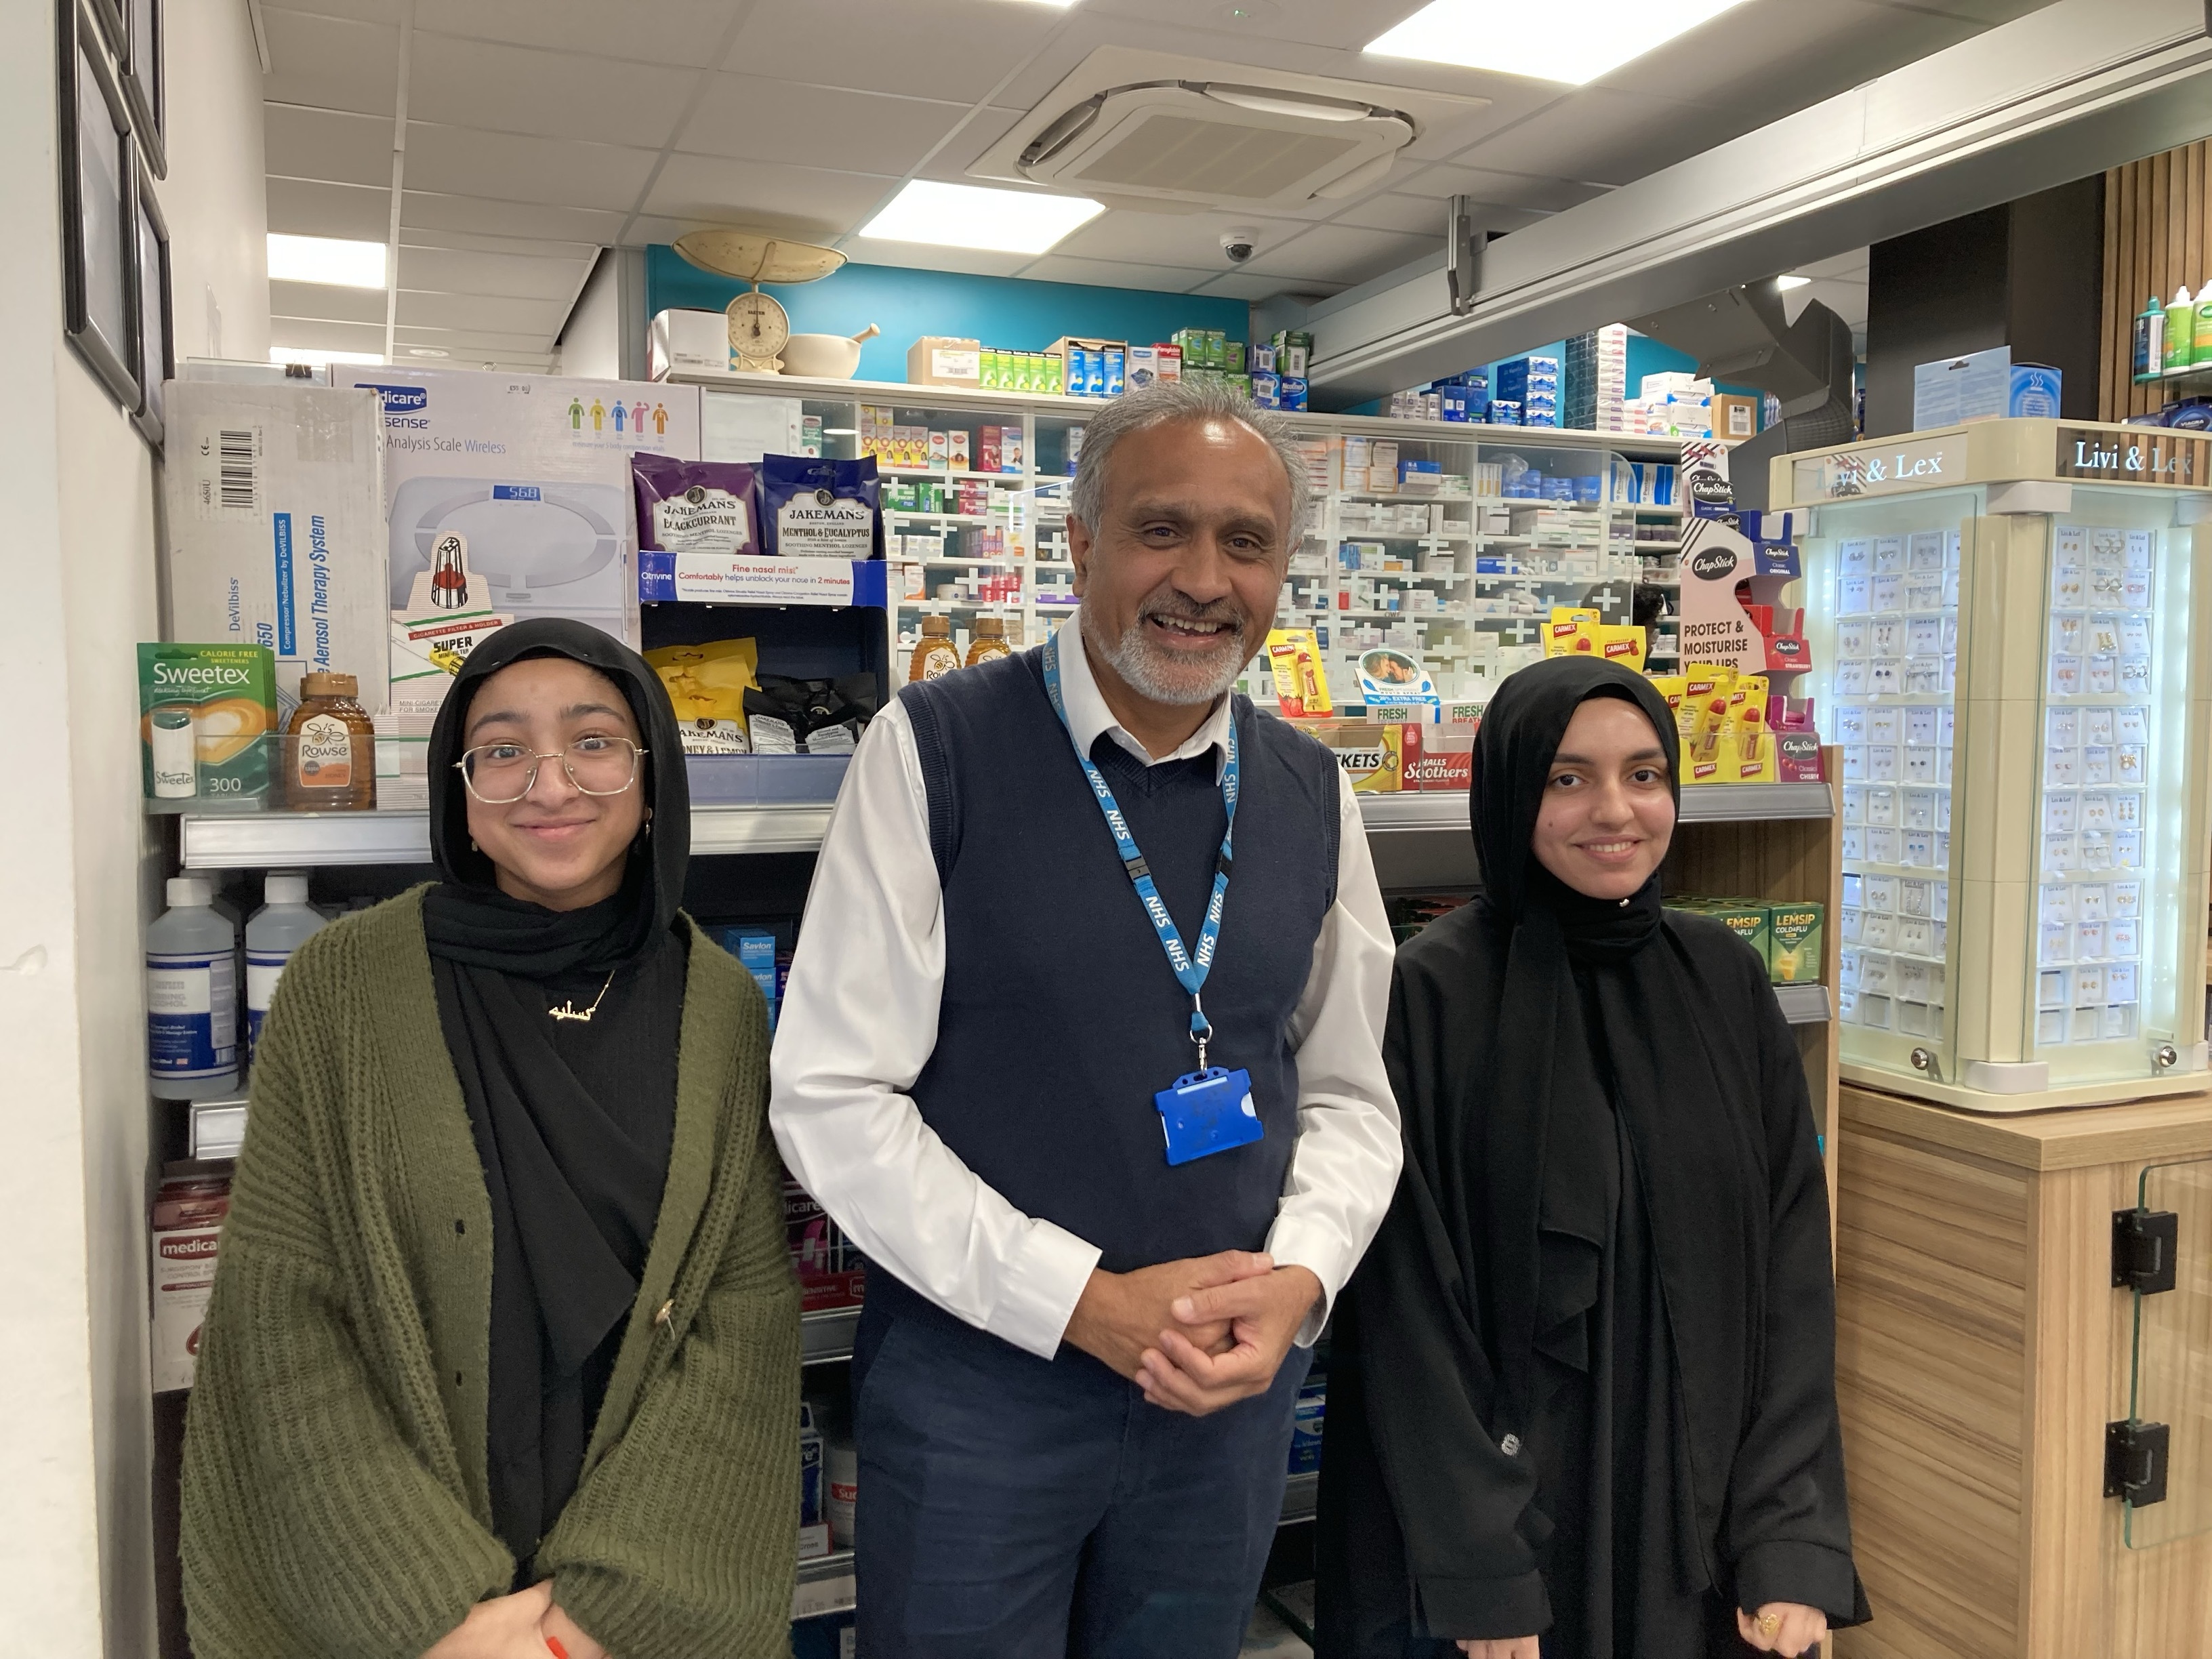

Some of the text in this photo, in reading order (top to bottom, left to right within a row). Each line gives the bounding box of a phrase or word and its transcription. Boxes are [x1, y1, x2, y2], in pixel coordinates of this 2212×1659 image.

[382, 391, 422, 405] dicare
[386, 434, 507, 454] Analysis Scale Wireless
[2075, 441, 2192, 475] Livi & Lex
[1866, 458, 1887, 483] &
[1896, 454, 1943, 479] Lex
[203, 479, 211, 505] 4650U
[1693, 482, 1733, 495] ChapStick
[664, 501, 736, 516] JAKEMANS
[789, 509, 864, 520] JAKEMANS
[663, 515, 737, 532] BLACKCURRANT
[278, 518, 287, 558] DeVILBISS
[309, 515, 330, 562] System
[782, 527, 870, 539] MENTHOL & EUCALYPTUS
[732, 565, 750, 573] Fine
[752, 565, 776, 573] nasal
[1694, 555, 1735, 573] ChapStick
[641, 571, 672, 581] Otrivine
[678, 572, 724, 583] Comfortably
[724, 574, 744, 583] helps
[745, 574, 774, 583] unblock
[775, 576, 790, 584] your
[810, 576, 817, 584] in
[817, 576, 823, 584] 2
[823, 577, 851, 585] minutes
[311, 562, 331, 615] Therapy
[228, 577, 241, 632] DeVilbiss
[413, 628, 447, 639] CIGARETTE
[447, 624, 468, 632] FILTER
[474, 619, 499, 628] HOLDER
[1554, 624, 1576, 634] CARMEX
[1684, 619, 1744, 637] PROTECT &
[312, 616, 331, 668] Aerosol
[433, 636, 473, 653] SUPER
[1271, 644, 1295, 653] CARMEX
[1605, 642, 1631, 653] CARMEX
[1684, 638, 1748, 655] MOISTURISE
[438, 649, 470, 659] MINI-FILTER
[1044, 647, 1057, 672] NHS
[153, 662, 251, 684] Sweetex
[926, 670, 945, 680] Row
[1689, 682, 1714, 692] CARMEX
[1048, 682, 1062, 712] NHS
[1669, 696, 1681, 704] CAR
[1732, 693, 1745, 701] MEX
[1378, 708, 1408, 720] FRESH
[1452, 705, 1483, 718] FRESH
[679, 729, 743, 744] AKEMANS
[302, 744, 348, 758] Rowse
[1783, 740, 1819, 753] ChapStick
[1337, 753, 1380, 768] KETS
[1418, 758, 1447, 767] HALLS
[1404, 762, 1469, 780] Soothers
[1695, 764, 1717, 774] CARMEX
[1742, 764, 1762, 774] CARMEX
[155, 771, 195, 785] Sweetex
[209, 777, 242, 792] 300
[1087, 769, 1111, 798] NHS
[1223, 773, 1236, 804] NHS
[1107, 810, 1130, 841] NHS
[1145, 895, 1171, 928] NHS
[1209, 890, 1225, 924] NHS
[1726, 917, 1761, 928] EMSIP
[1776, 914, 1816, 926] LEMSIP
[743, 942, 772, 951] Savlon
[1197, 933, 1214, 968] NHS
[1166, 939, 1190, 972] NHS
[754, 973, 773, 981] vlon
[784, 1200, 822, 1214] icare
[163, 1239, 218, 1255] medica
